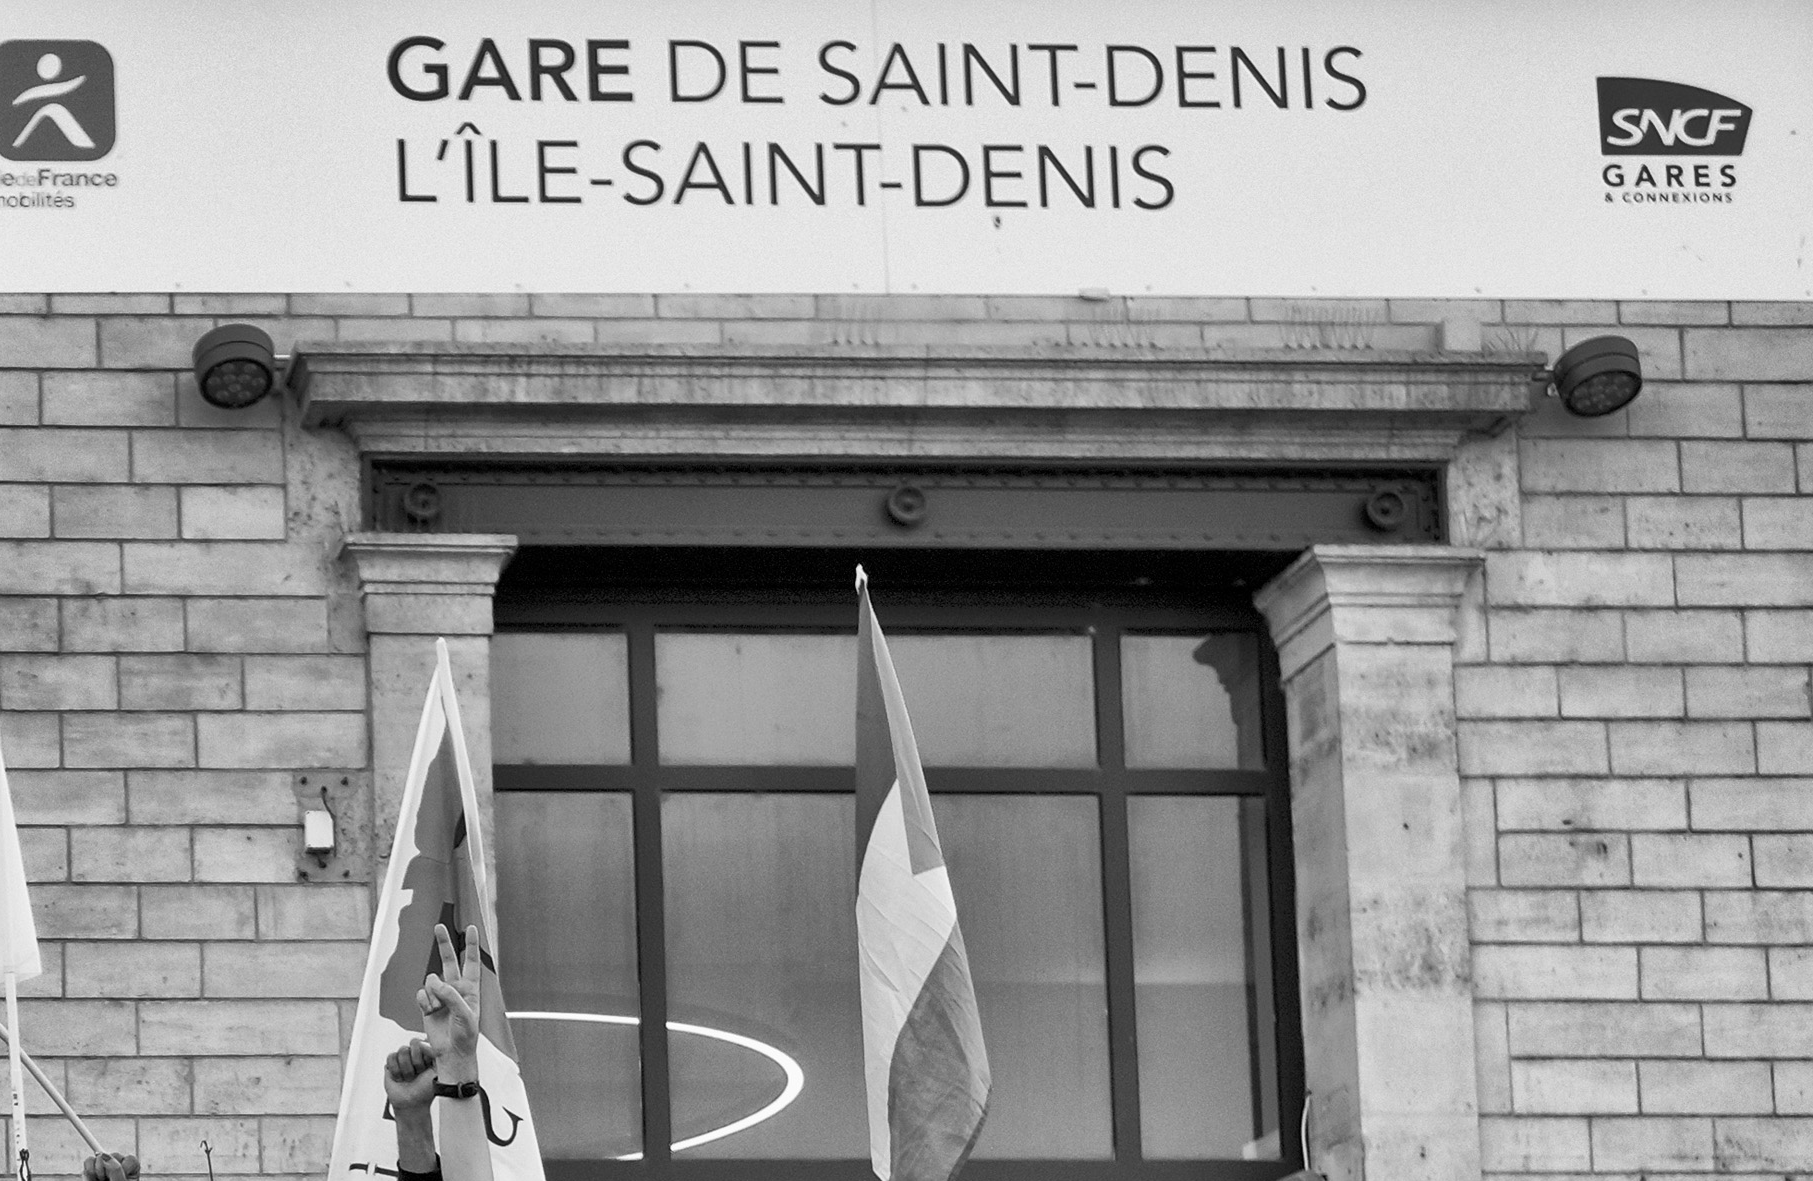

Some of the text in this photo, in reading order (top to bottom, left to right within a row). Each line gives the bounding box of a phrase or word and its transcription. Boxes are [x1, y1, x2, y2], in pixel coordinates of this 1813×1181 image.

[387, 36, 1368, 112] GARE DE SAINT-DENIS
[1606, 107, 1742, 147] SNCF
[1602, 163, 1737, 188] GARES
[1622, 191, 1734, 203] CONNEXIONS
